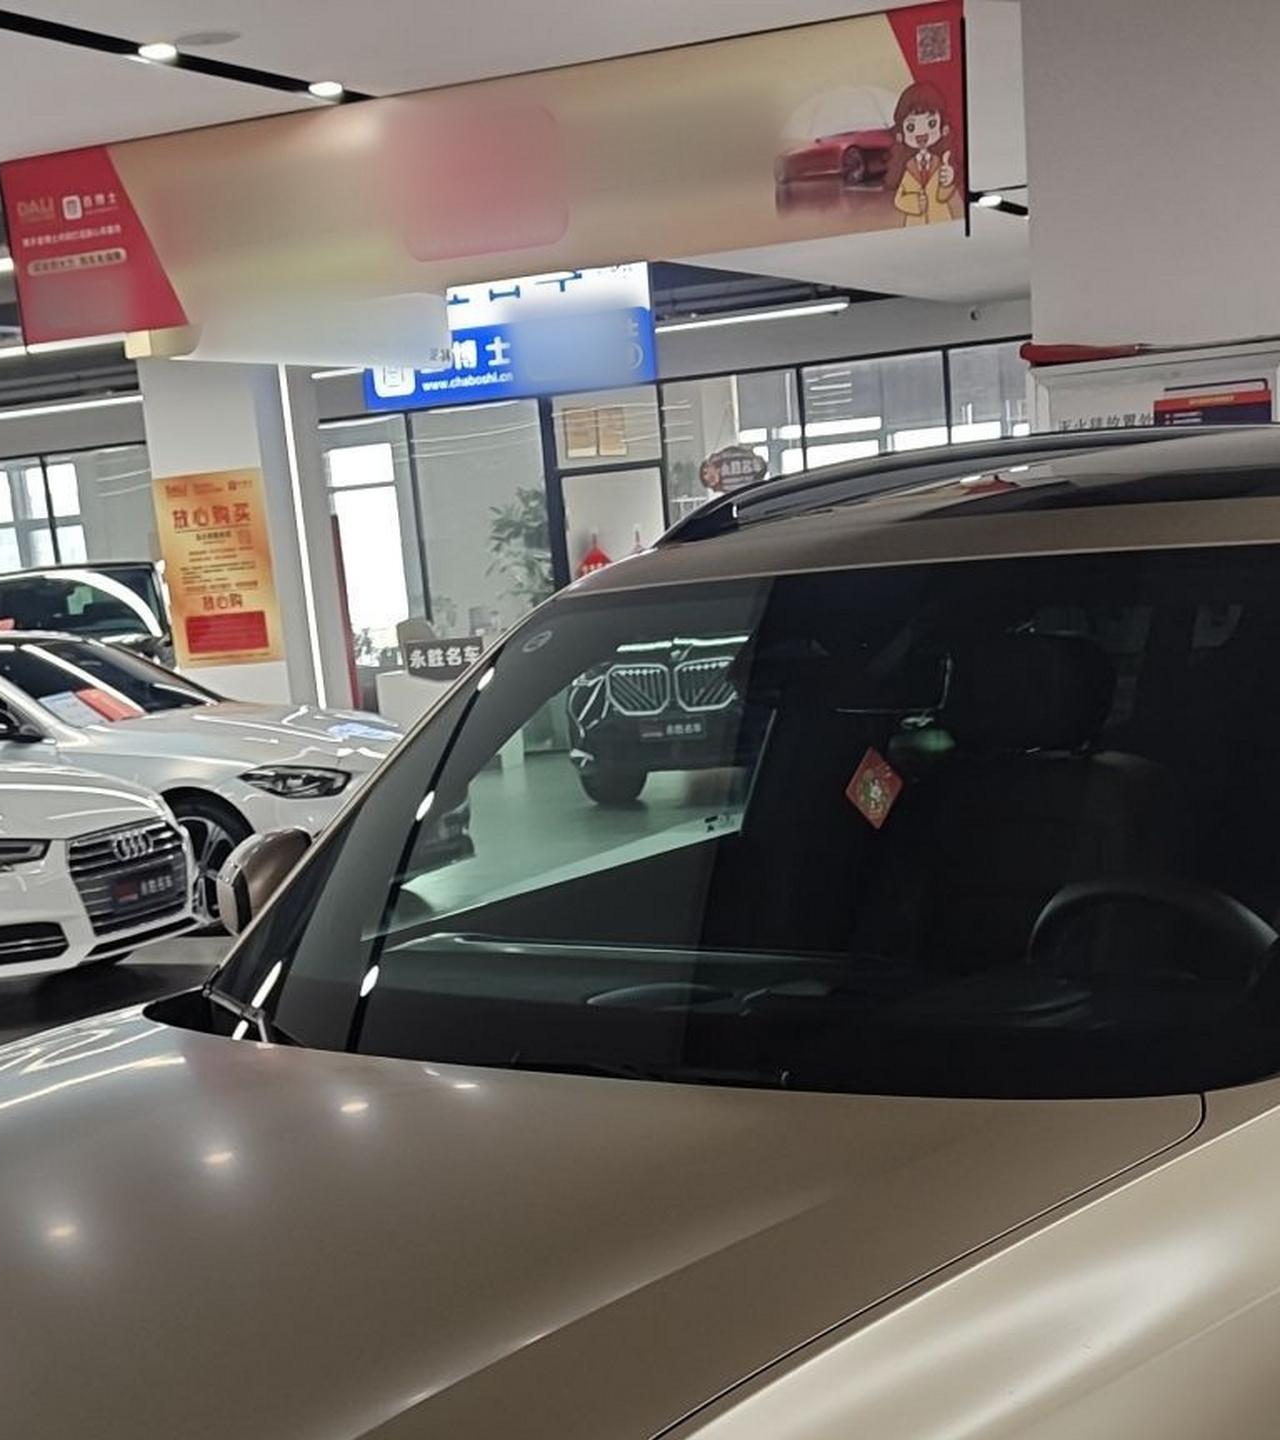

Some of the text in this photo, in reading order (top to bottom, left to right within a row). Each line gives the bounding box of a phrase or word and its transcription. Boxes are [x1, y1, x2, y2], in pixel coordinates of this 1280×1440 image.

[421, 371, 514, 392] www.chaboshi.cn
[172, 502, 251, 529] 放心购买
[409, 644, 481, 669] 永胜名车
